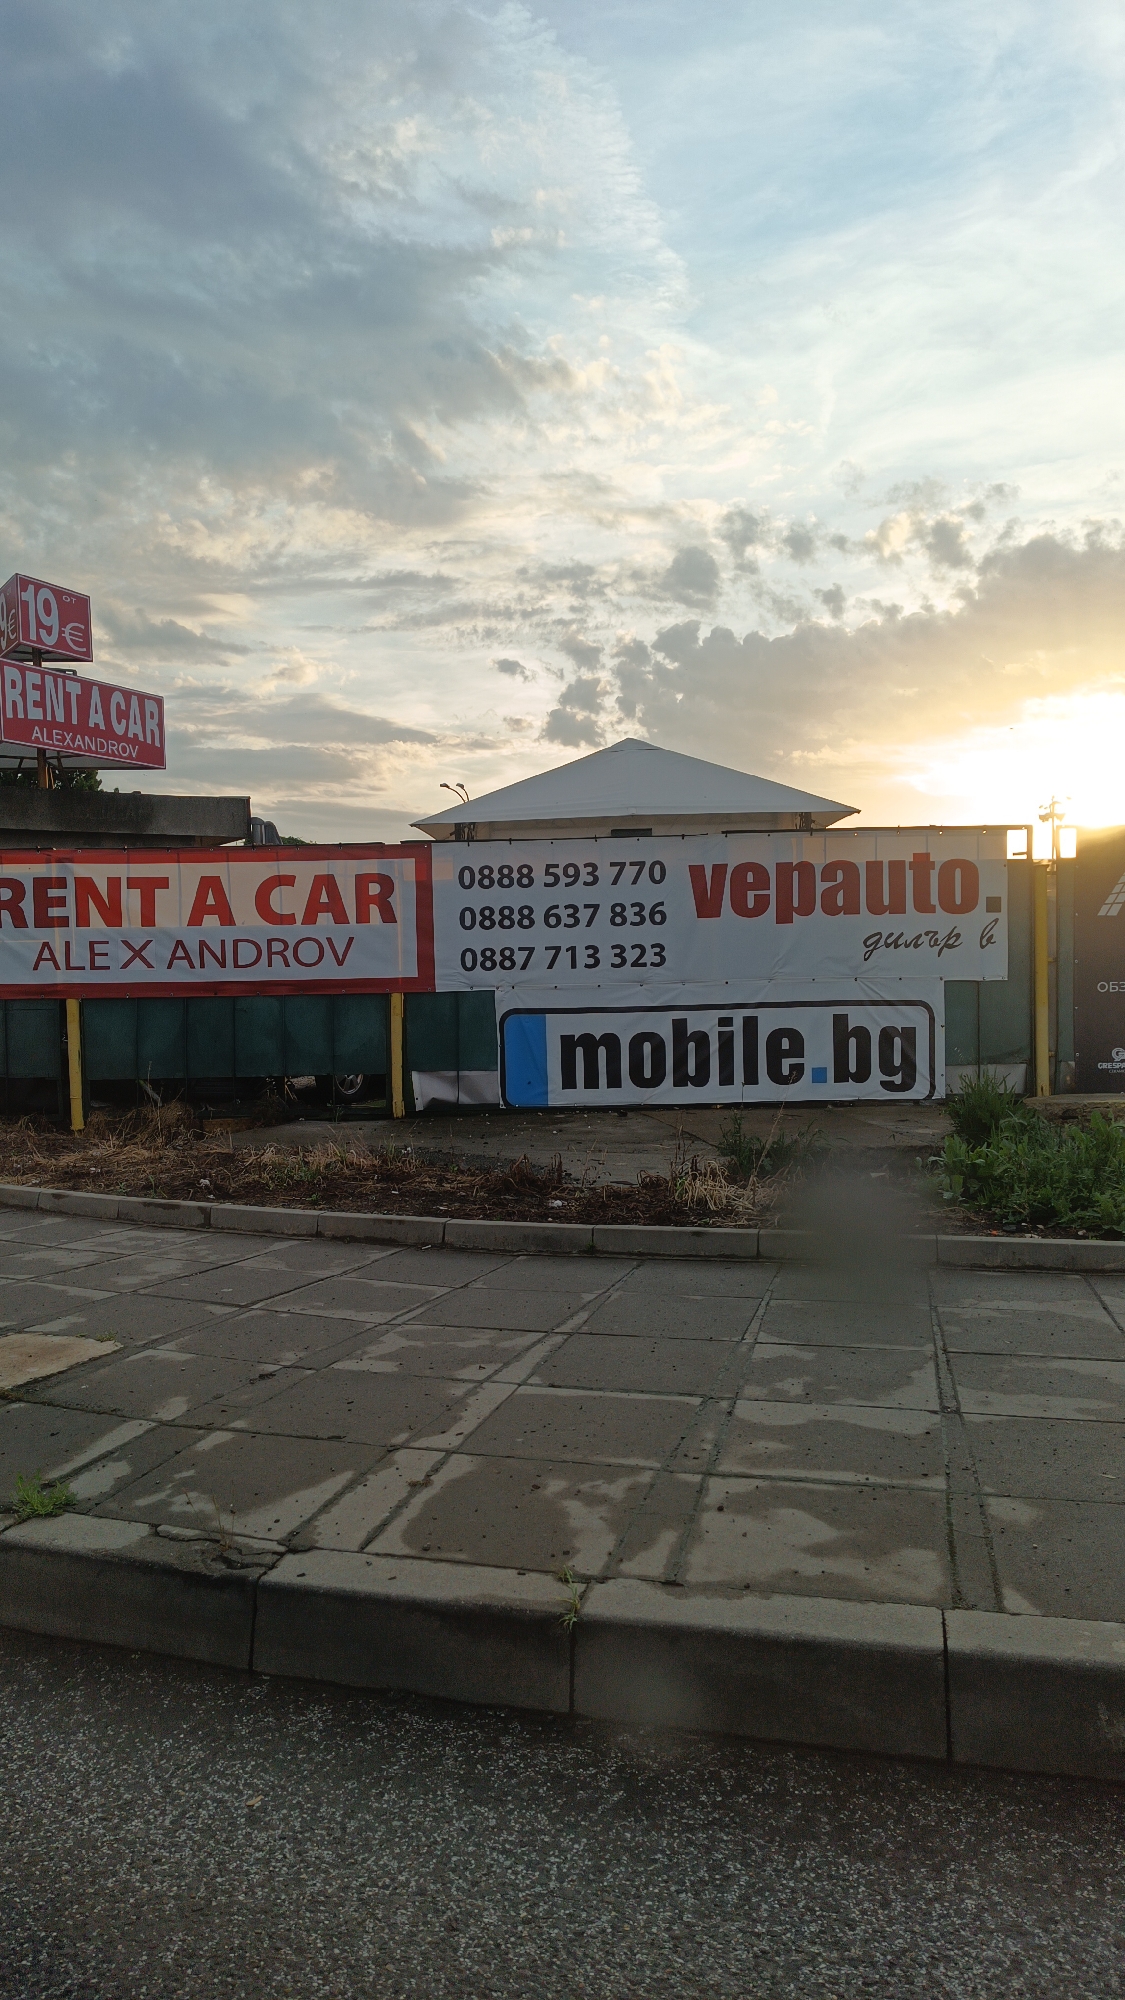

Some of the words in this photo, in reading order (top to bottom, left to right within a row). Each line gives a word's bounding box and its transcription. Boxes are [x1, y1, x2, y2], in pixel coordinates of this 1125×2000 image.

[4, 665, 81, 725] RENT
[88, 686, 106, 731] A
[110, 691, 161, 748] CAR
[32, 726, 139, 758] ALEXANDROV
[458, 864, 535, 890] 0888
[543, 862, 600, 888] 593
[609, 860, 667, 886] 770
[0, 876, 170, 929] RENT
[187, 875, 236, 927] A
[254, 873, 398, 926] CAR
[459, 905, 536, 930] 0888
[543, 903, 600, 929] 637
[609, 901, 667, 927] 836
[32, 936, 355, 971] ALEXANDROV
[460, 946, 536, 972] 0887
[544, 944, 601, 970] 713
[610, 943, 667, 969] 323
[560, 1013, 917, 1093] mobile.bg
